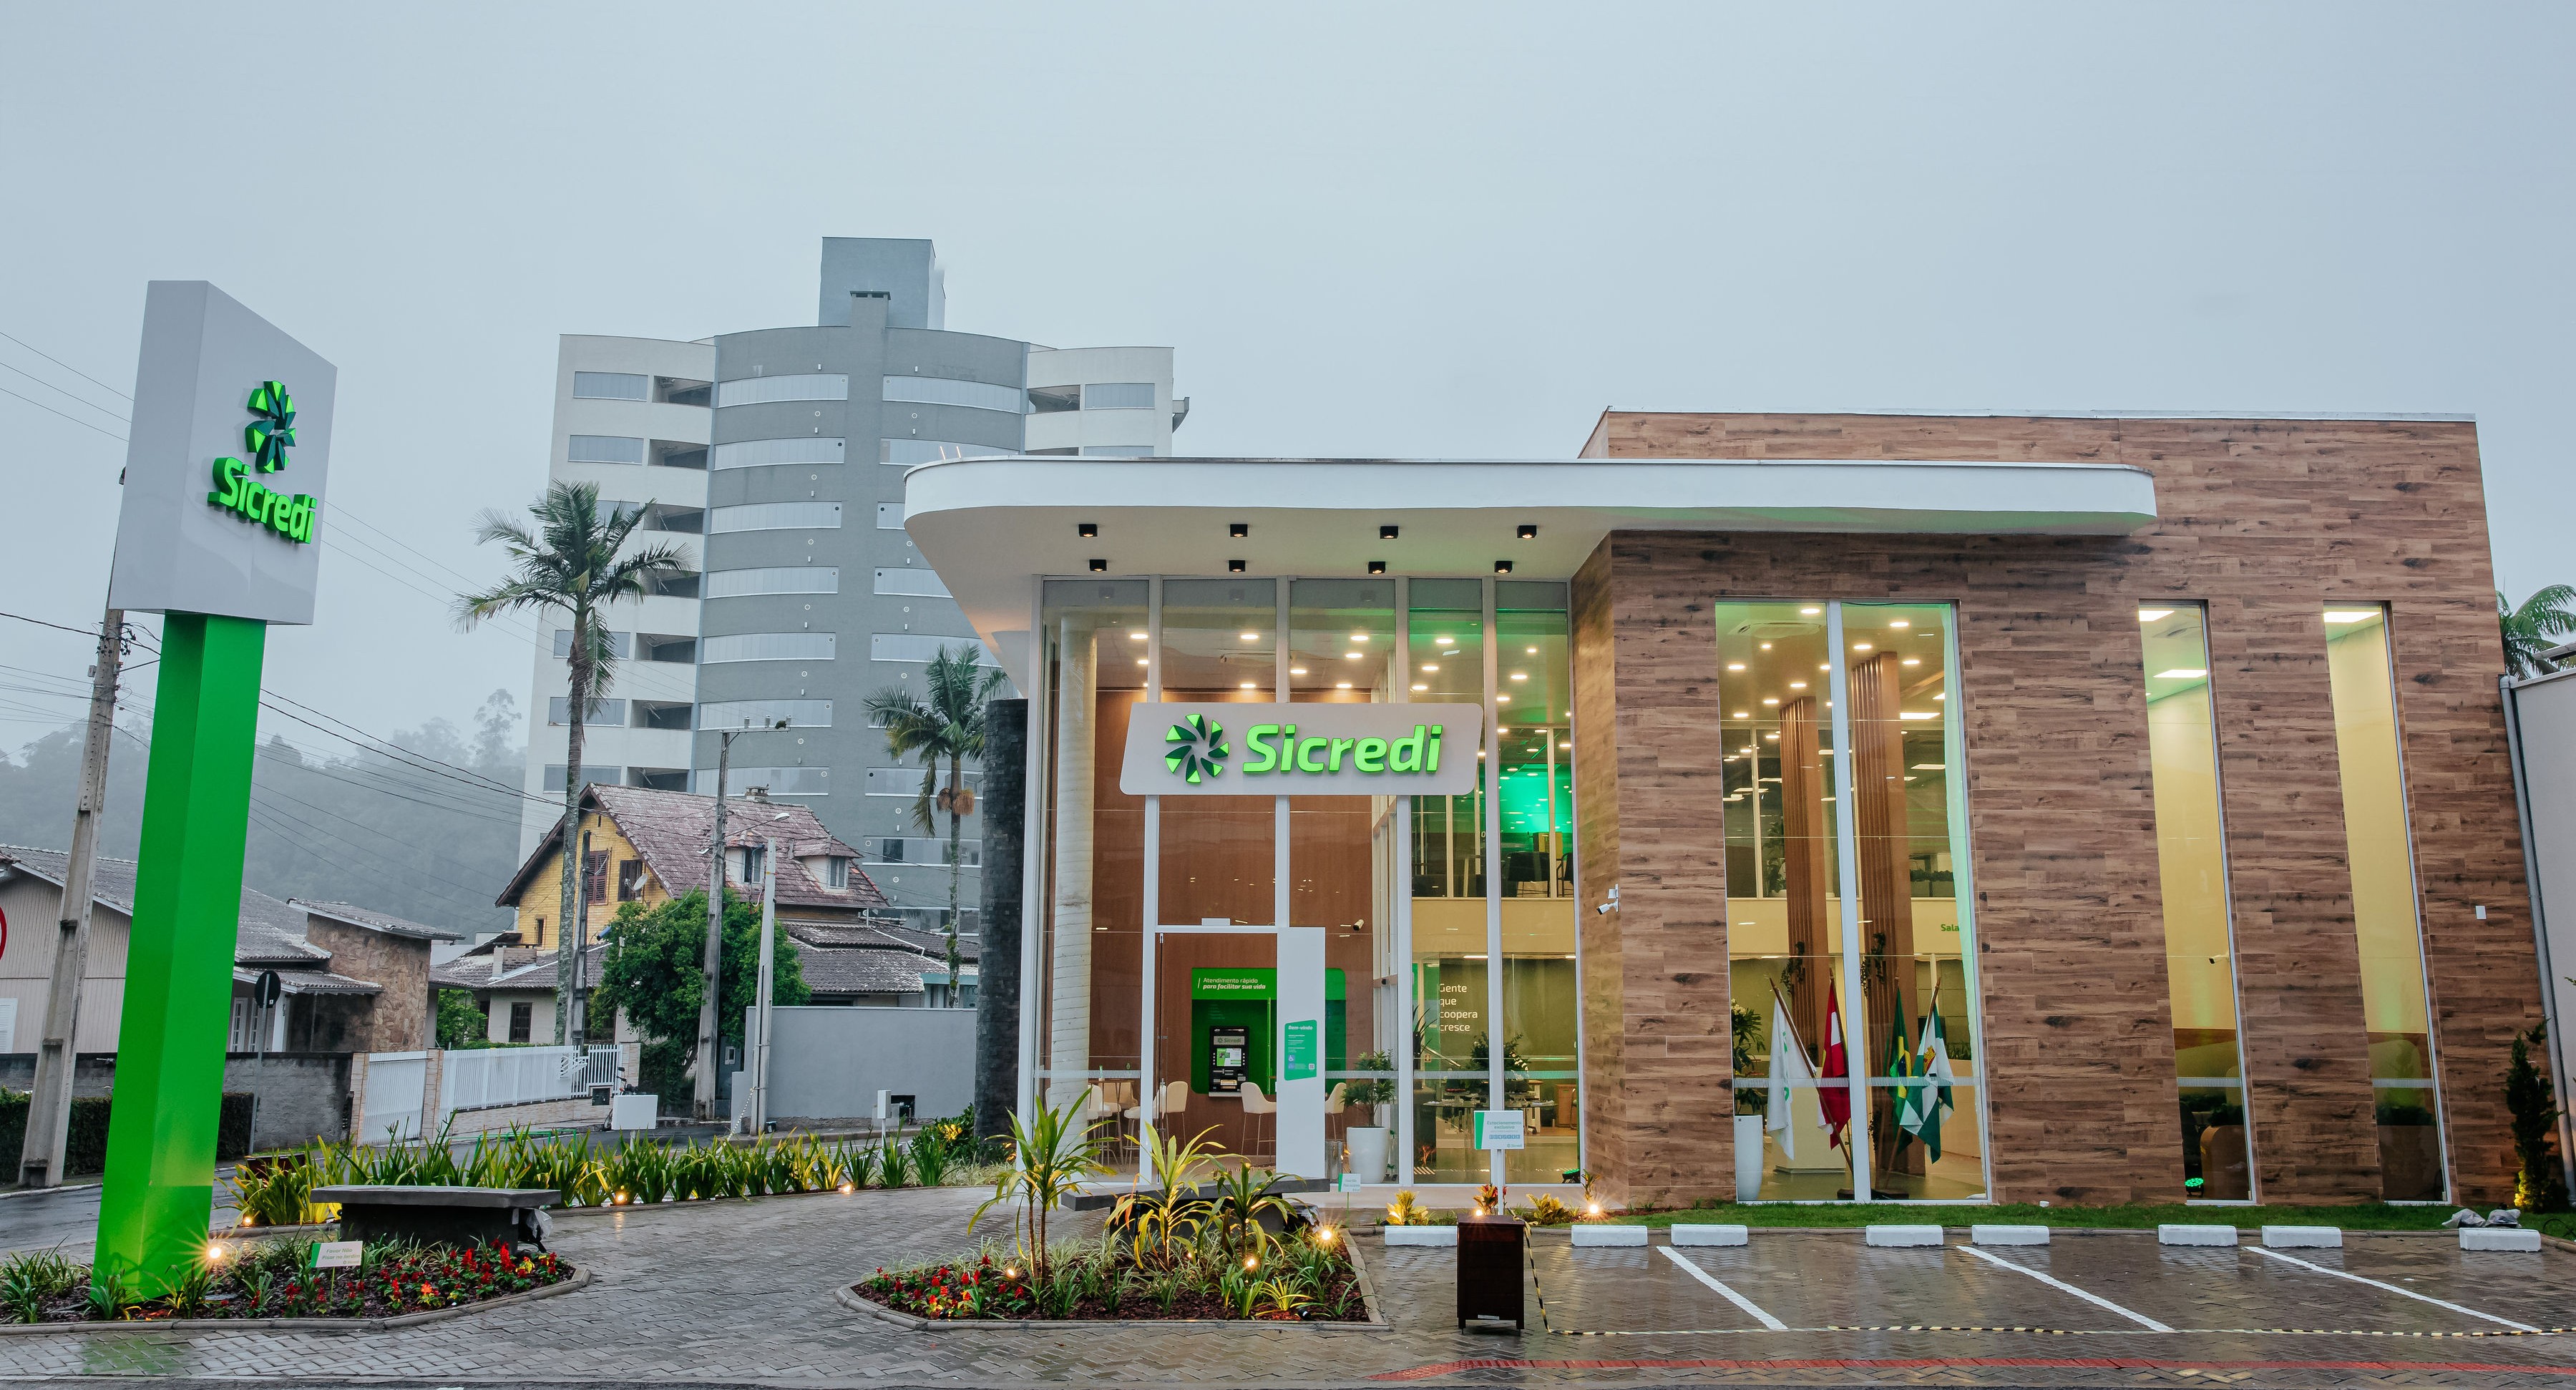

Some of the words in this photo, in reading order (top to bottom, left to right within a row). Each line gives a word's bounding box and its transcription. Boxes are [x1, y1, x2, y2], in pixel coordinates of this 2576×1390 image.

[208, 457, 317, 544] Sicredi
[1243, 724, 1443, 773] Sicredi
[1440, 983, 1467, 992] Gente
[1440, 998, 1457, 1007] que
[1440, 1012, 1478, 1020] coopera
